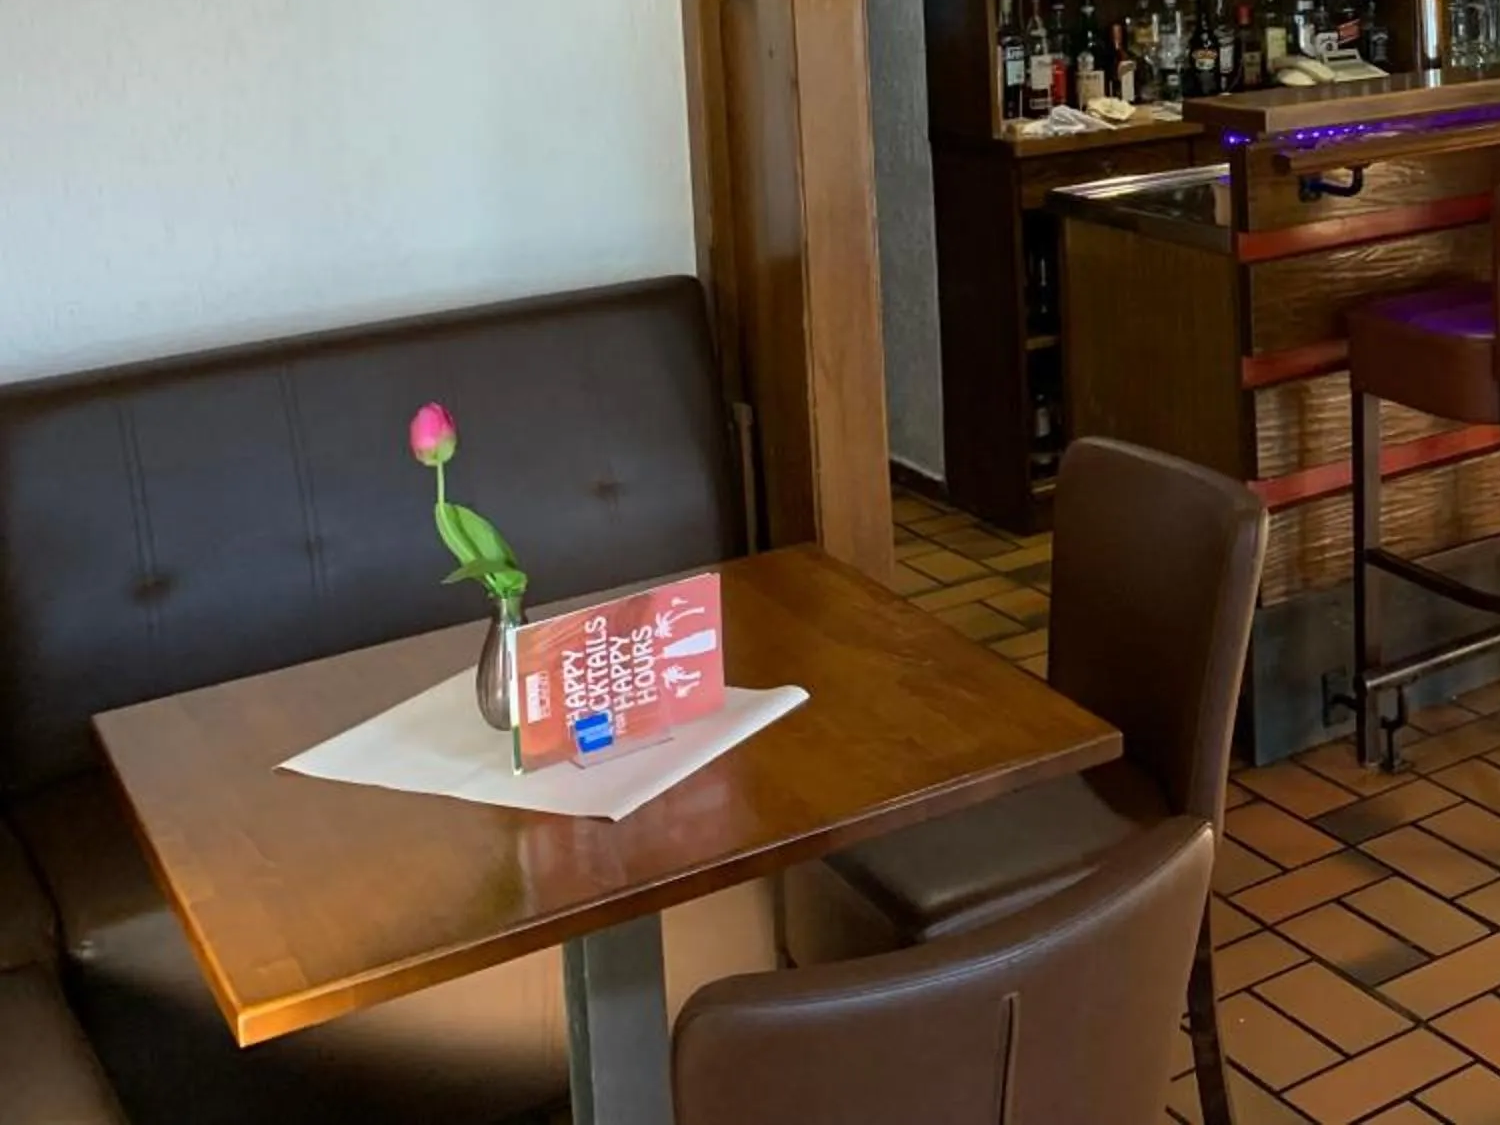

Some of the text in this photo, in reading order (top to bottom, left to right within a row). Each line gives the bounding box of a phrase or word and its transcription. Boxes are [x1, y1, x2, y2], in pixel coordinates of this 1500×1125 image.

[585, 616, 614, 734] CKTAILS
[609, 636, 635, 712] HAPPY
[632, 625, 658, 705] HOURS
